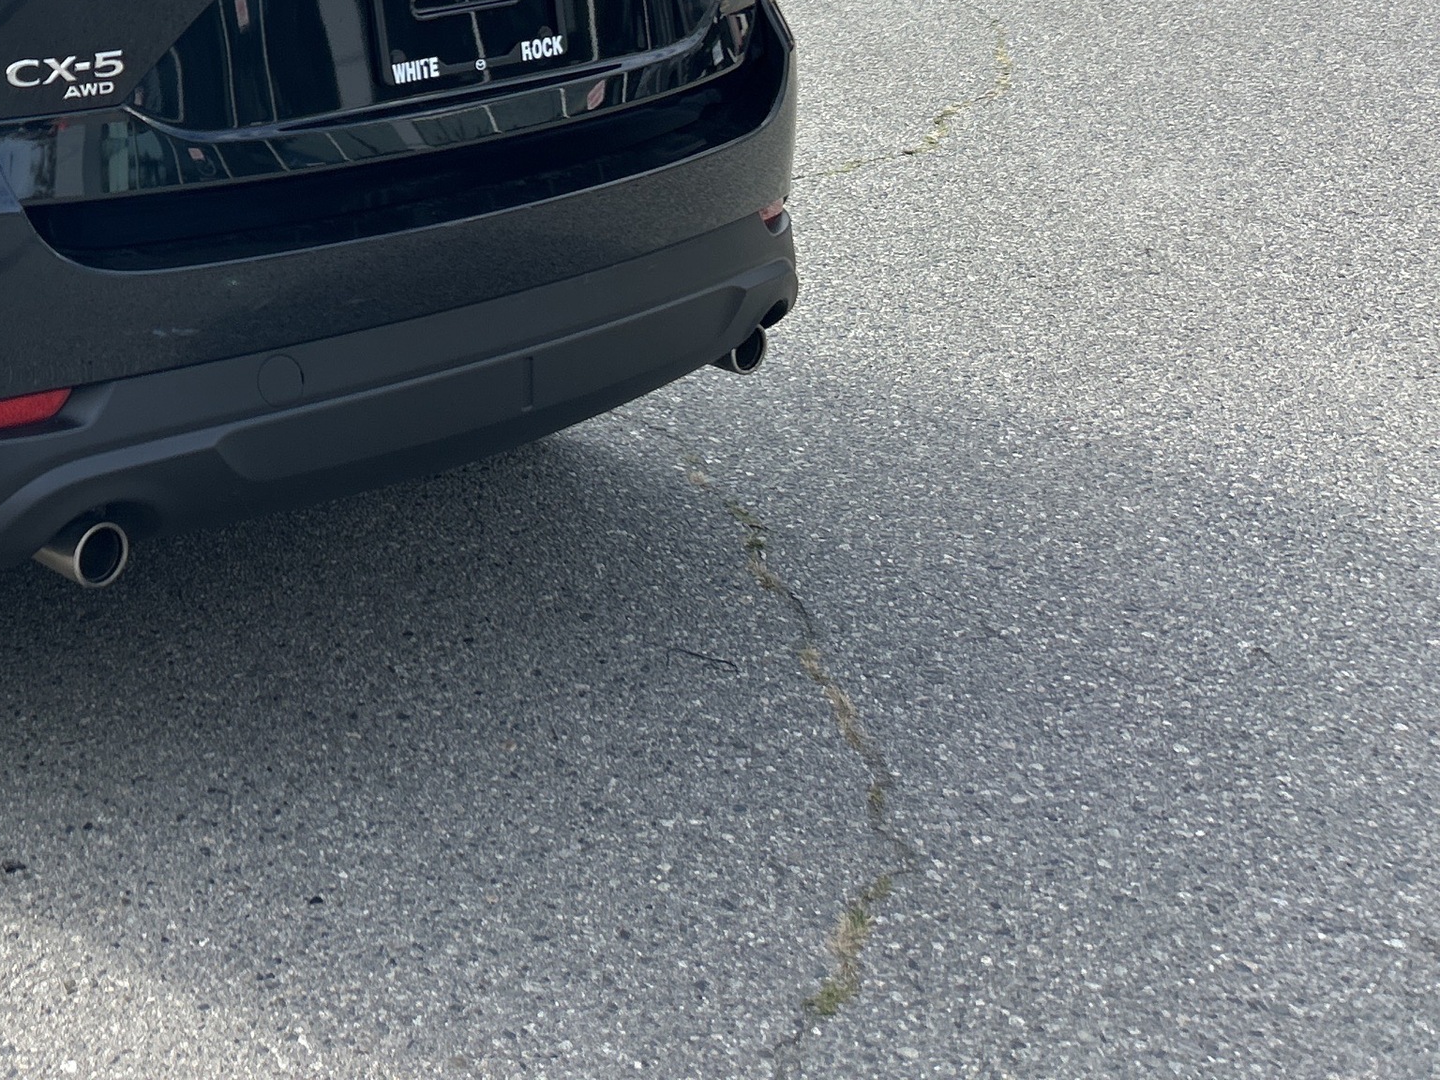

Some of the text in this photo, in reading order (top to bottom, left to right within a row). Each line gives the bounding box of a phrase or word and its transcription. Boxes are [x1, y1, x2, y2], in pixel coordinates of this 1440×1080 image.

[521, 35, 564, 62] ROCK
[5, 49, 125, 88] CX-5
[392, 56, 441, 85] WHITE
[63, 81, 115, 100] AWD
